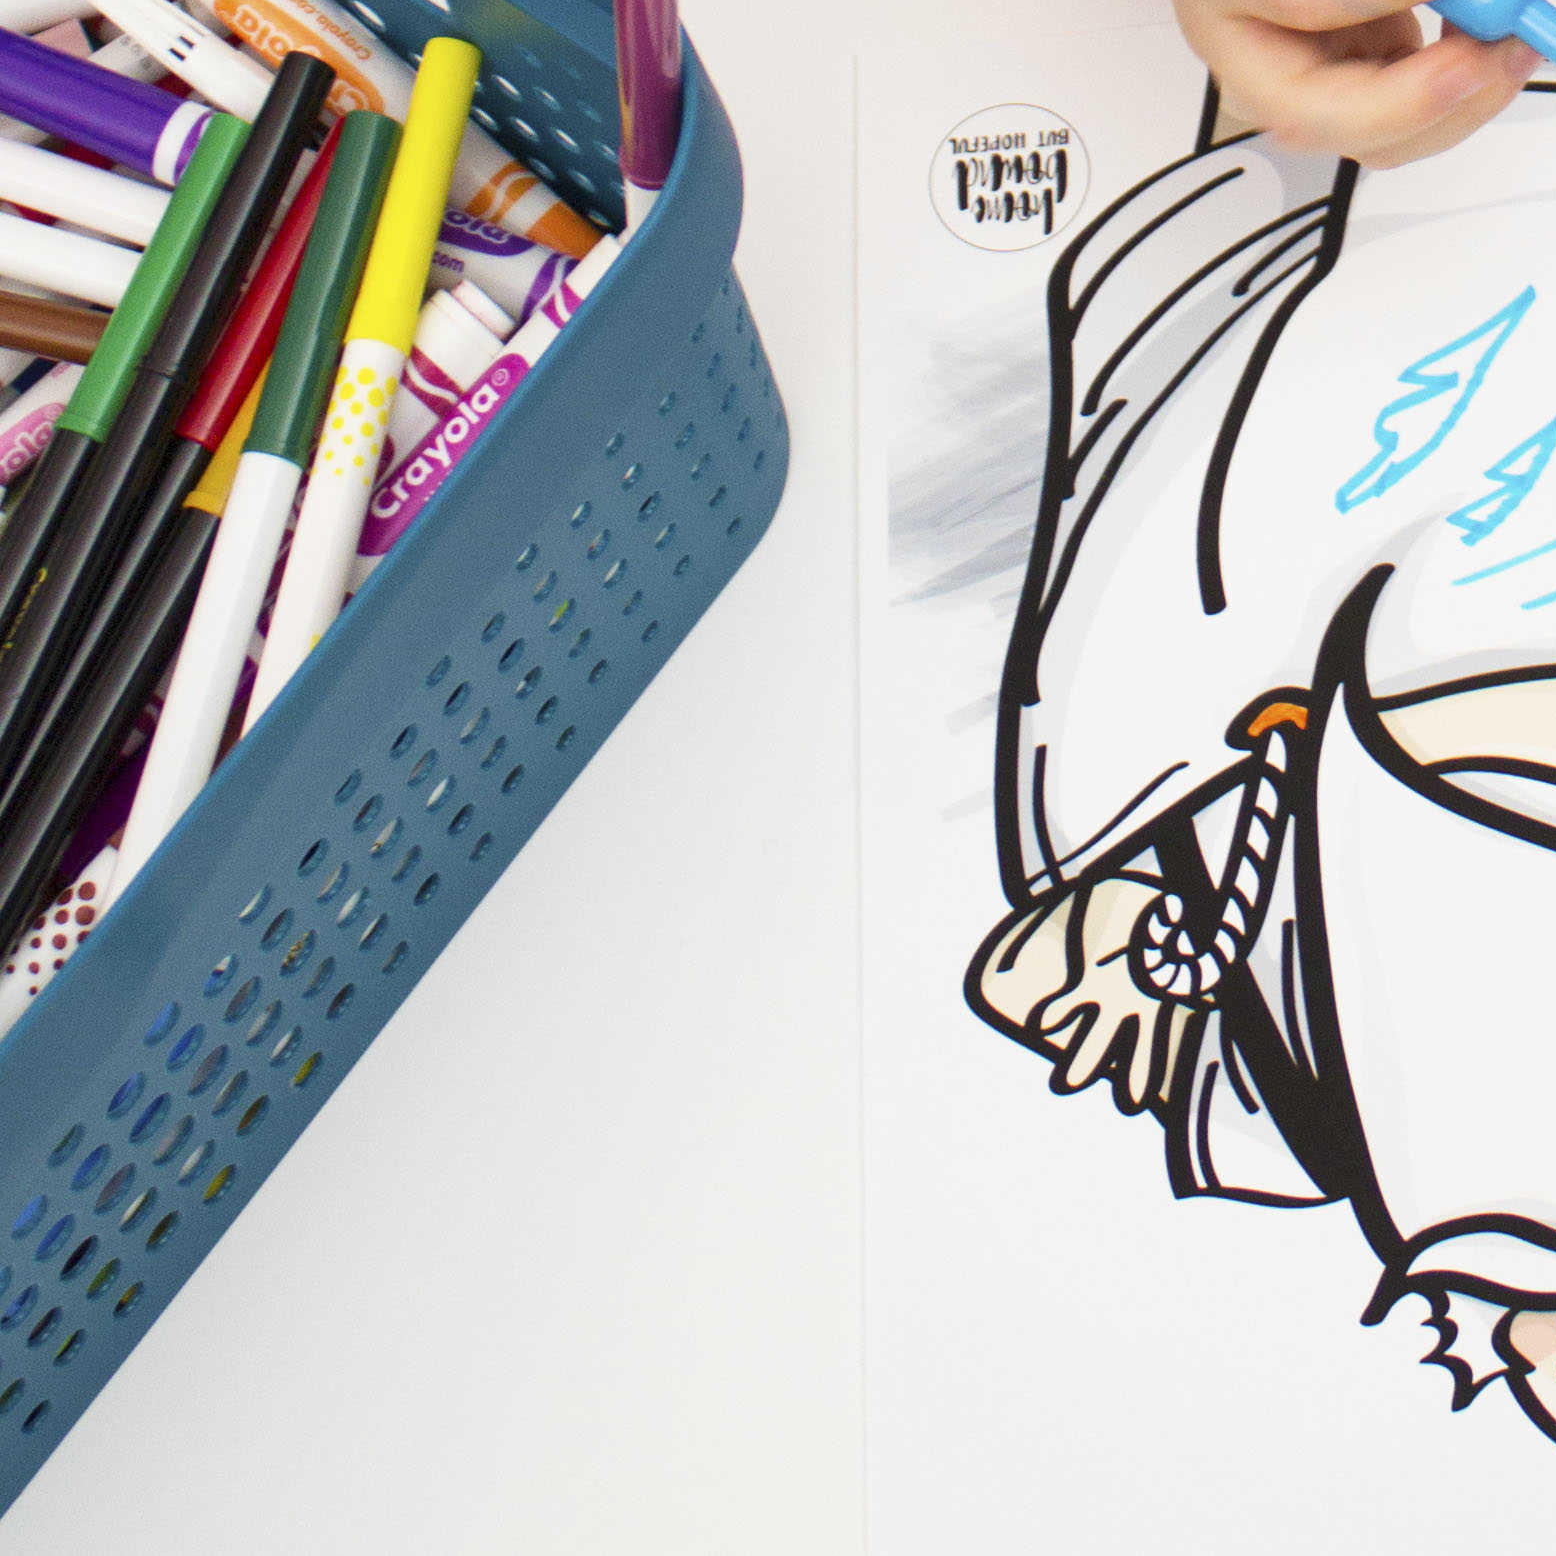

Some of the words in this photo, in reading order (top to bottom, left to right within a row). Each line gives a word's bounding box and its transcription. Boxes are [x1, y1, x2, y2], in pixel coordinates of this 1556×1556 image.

[950, 133, 1026, 154] HOPEFUL
[1038, 128, 1070, 147] BUT
[953, 149, 1067, 211] bound
[971, 187, 1053, 235] home
